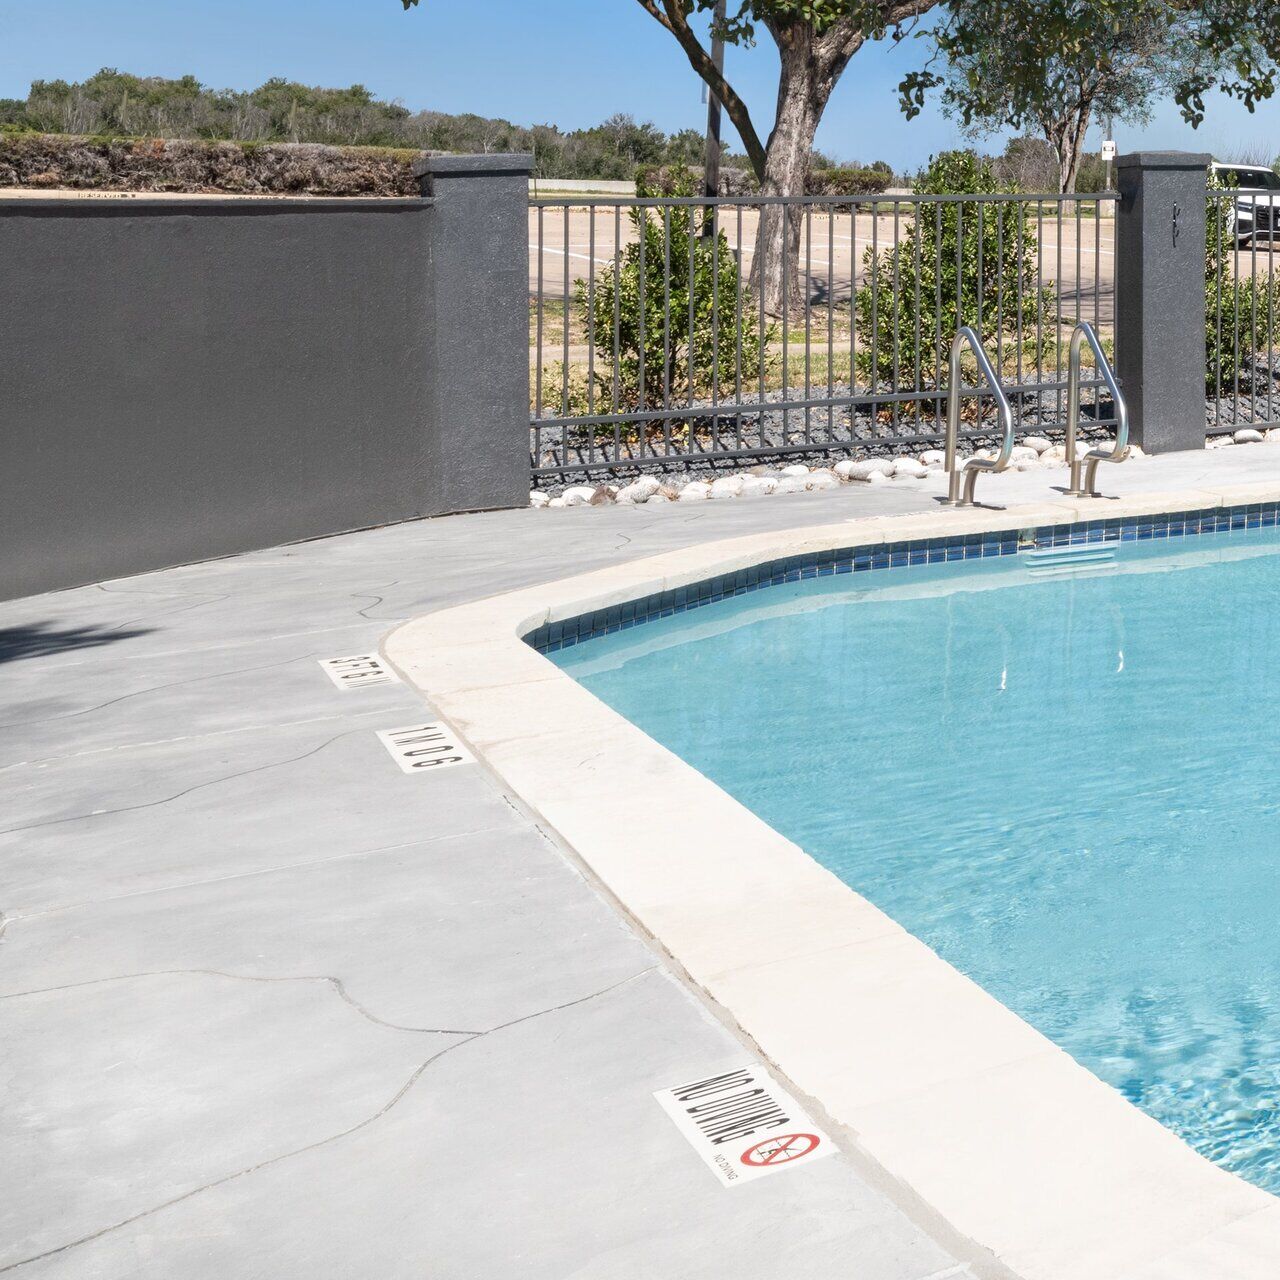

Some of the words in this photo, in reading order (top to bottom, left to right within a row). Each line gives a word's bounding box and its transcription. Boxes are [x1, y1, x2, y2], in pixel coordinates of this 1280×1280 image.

[670, 1069, 755, 1102] NO
[686, 1088, 790, 1146] DIVING
[713, 1153, 726, 1163] NO
[719, 1161, 739, 1180] DIVING
